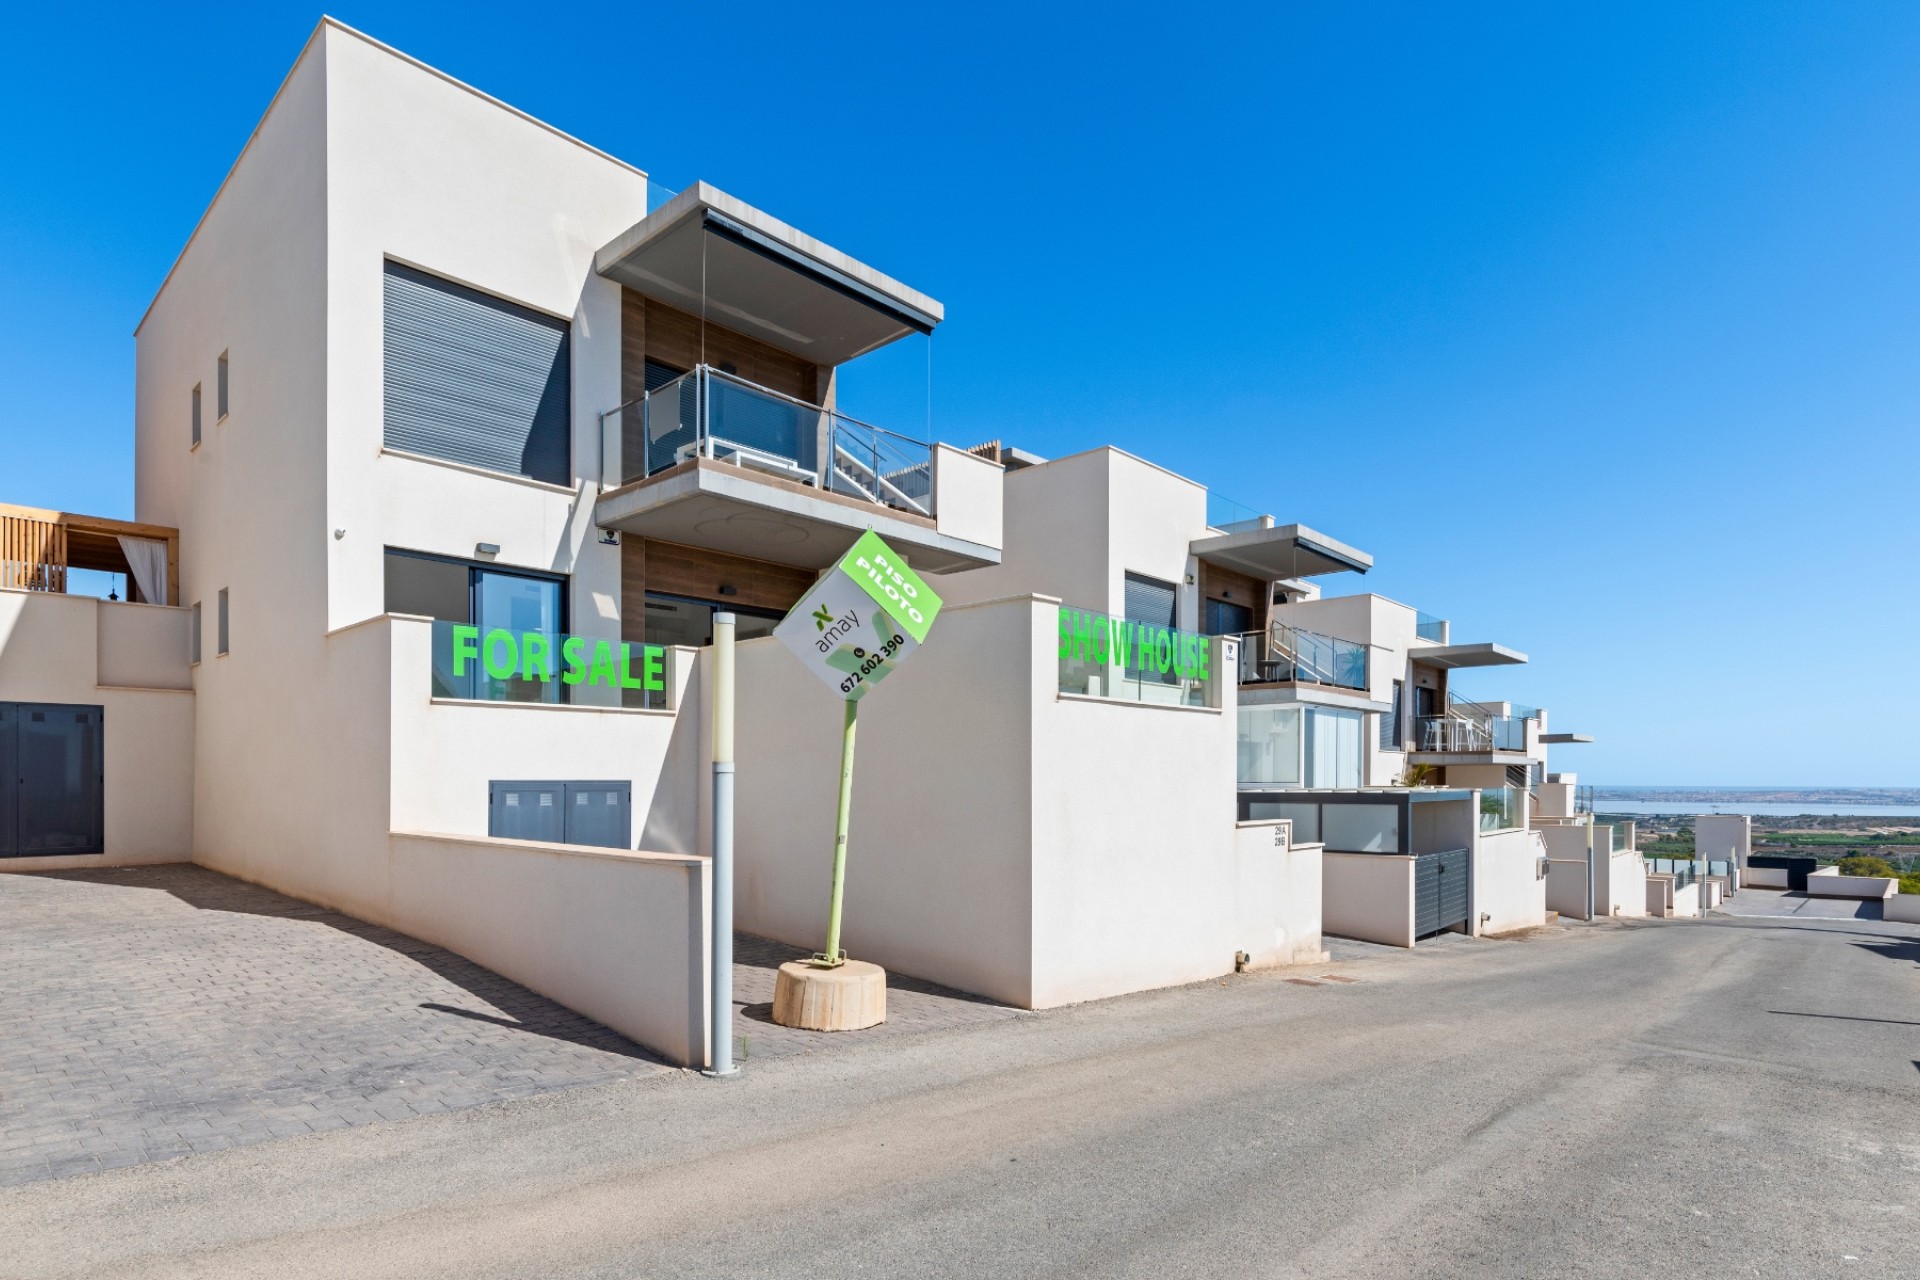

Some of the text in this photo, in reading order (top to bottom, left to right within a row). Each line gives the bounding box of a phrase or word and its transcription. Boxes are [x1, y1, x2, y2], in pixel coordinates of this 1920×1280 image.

[855, 556, 924, 624] PILOTO
[874, 554, 918, 598] PISO
[452, 624, 664, 691] FOR SALE
[815, 609, 860, 653] amay
[1058, 607, 1209, 681] SHOW HOUSE
[840, 634, 904, 693] 672 602 390
